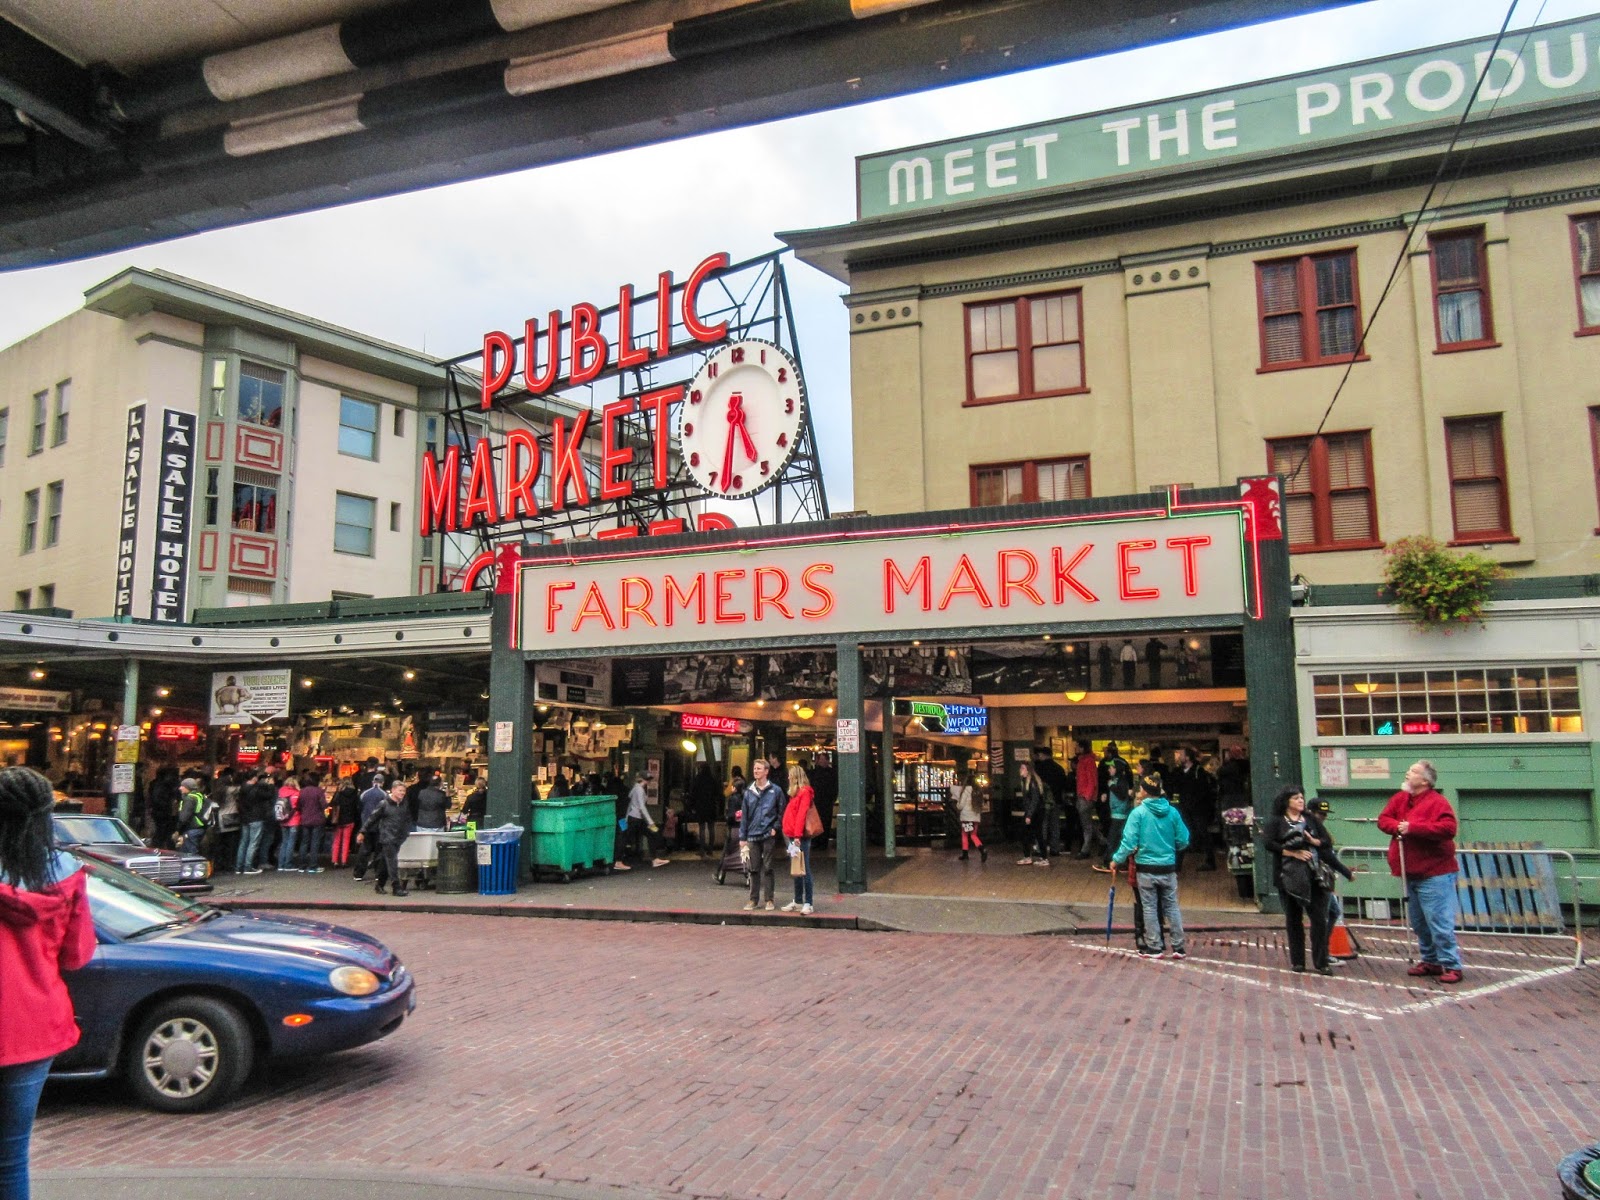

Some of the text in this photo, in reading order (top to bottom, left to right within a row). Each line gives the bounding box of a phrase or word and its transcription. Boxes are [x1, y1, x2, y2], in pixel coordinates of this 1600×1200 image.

[889, 32, 1600, 206] MEET THE PRODU
[481, 252, 730, 410] PUBLIC
[731, 347, 745, 364] 12
[760, 349, 766, 365] 1
[708, 362, 718, 379] 11
[778, 367, 787, 383] 2
[690, 389, 702, 405] 10
[784, 398, 794, 414] 3
[128, 411, 142, 443] LA
[684, 422, 693, 437] 9
[776, 432, 788, 447] 4
[420, 384, 685, 537] MARKET
[690, 452, 700, 467] 8
[760, 460, 770, 476] 5
[709, 471, 718, 486] 7
[732, 474, 743, 489] 6
[123, 446, 140, 529] SALLE
[156, 412, 190, 622] LA SALLE HOTEL
[884, 535, 1211, 614] MARKET
[546, 563, 835, 633] FARMERS
[682, 714, 704, 726] SOUND
[1320, 749, 1333, 758] NO
